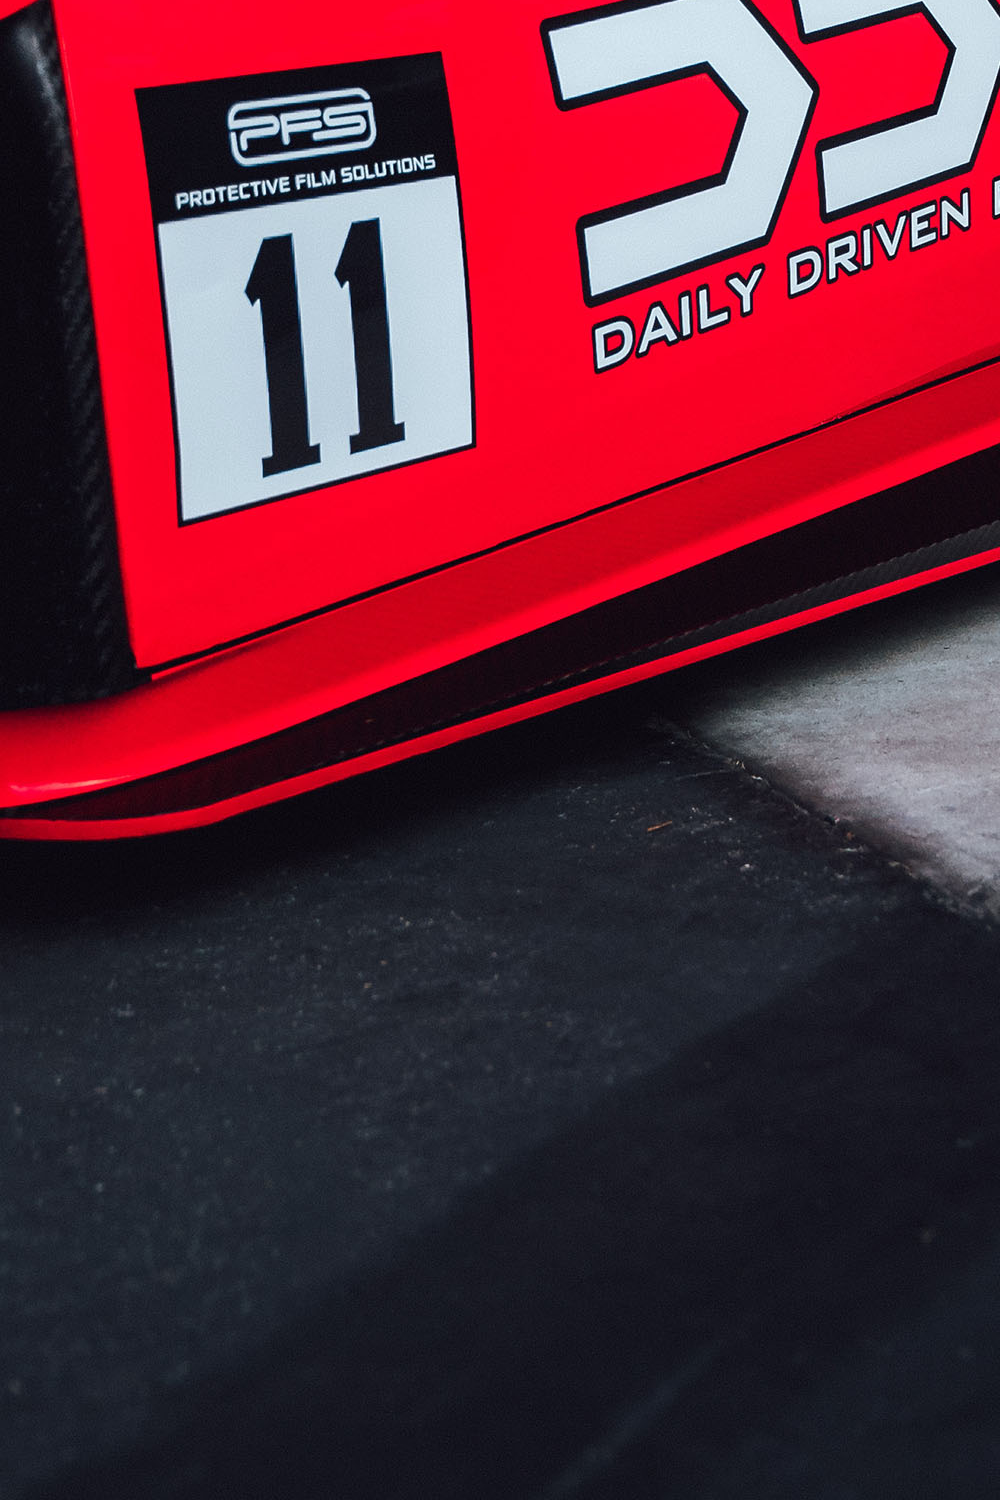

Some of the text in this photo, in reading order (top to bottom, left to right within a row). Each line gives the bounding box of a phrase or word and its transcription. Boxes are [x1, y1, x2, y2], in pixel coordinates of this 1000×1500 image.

[175, 153, 437, 210] PROTECTIVE FILM SOLUTIONS
[244, 217, 406, 478] 11
[591, 265, 765, 374] DAILY
[787, 189, 973, 298] DRIVEN
